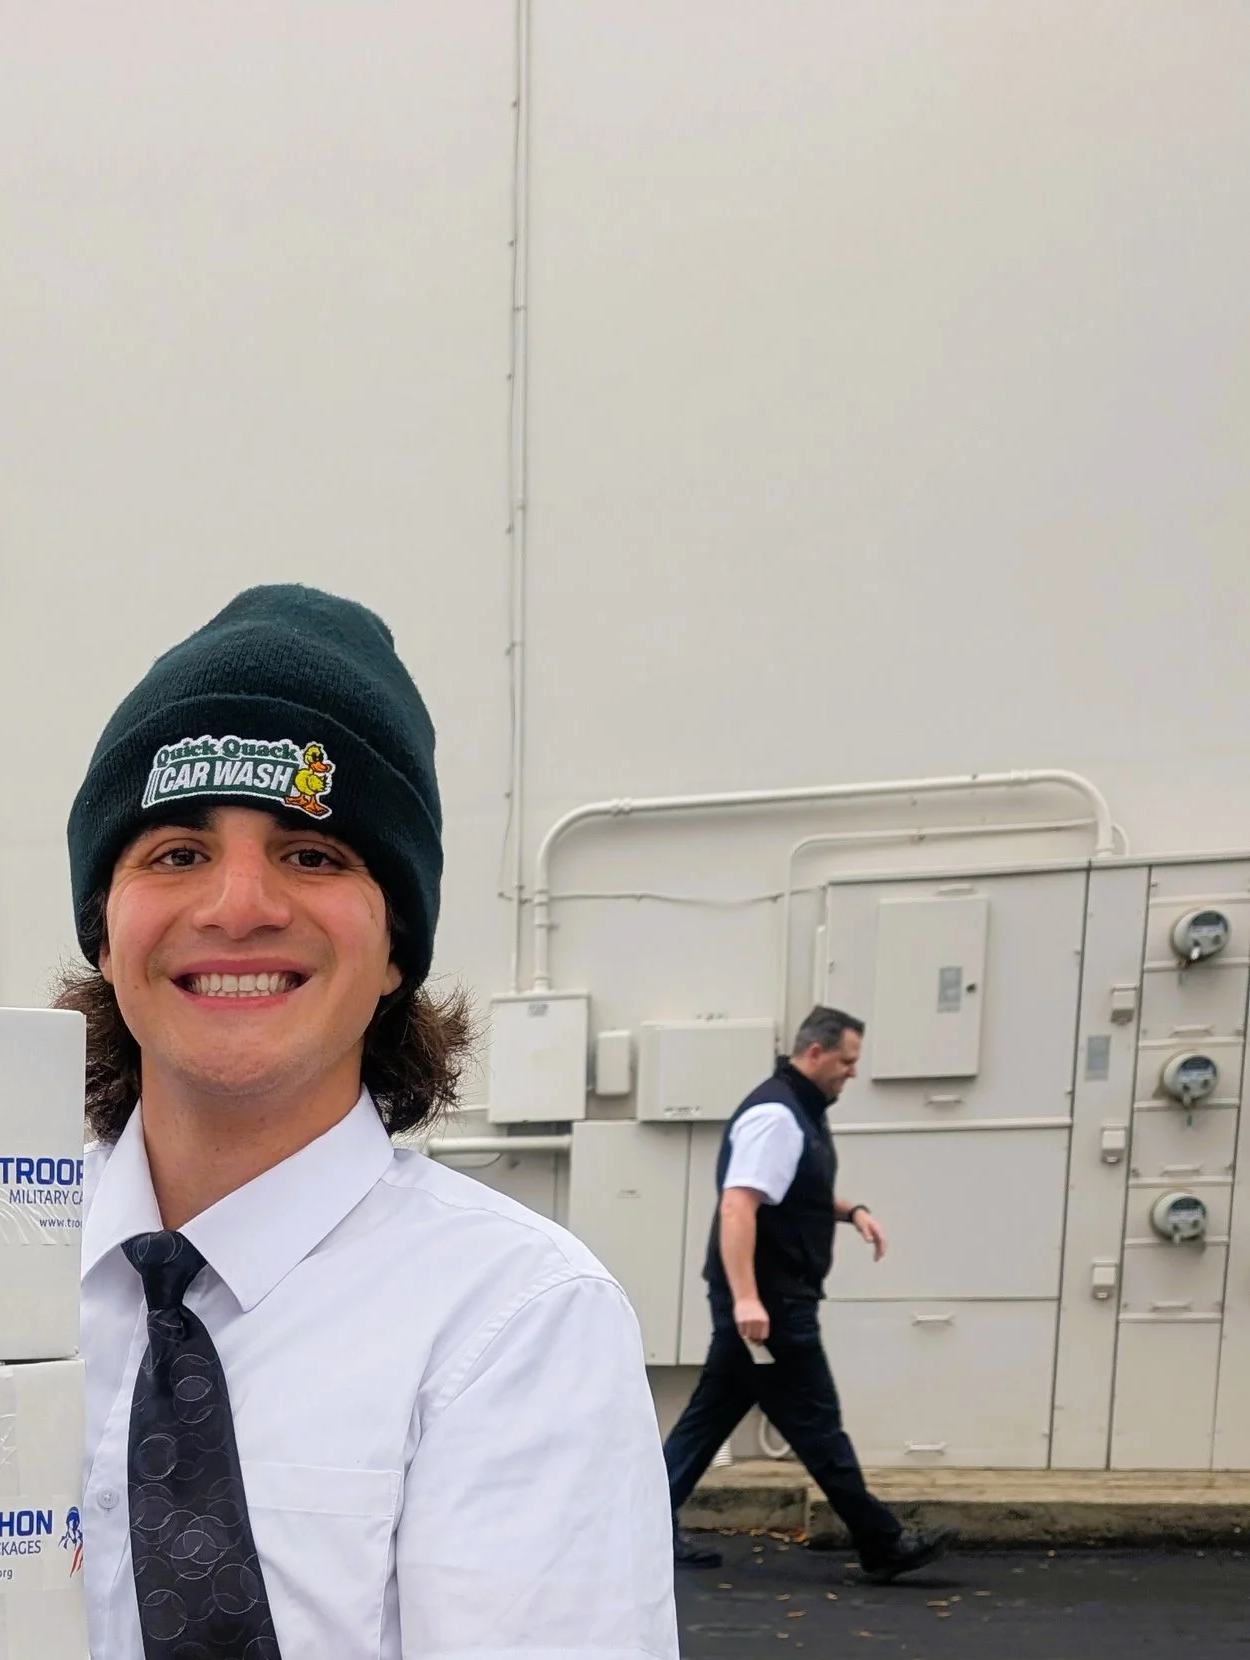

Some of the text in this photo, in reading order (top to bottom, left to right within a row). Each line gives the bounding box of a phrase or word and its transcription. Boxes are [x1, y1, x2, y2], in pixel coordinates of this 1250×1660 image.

[156, 737, 299, 767] Quick Quack
[159, 761, 294, 793] CAR WASH
[9, 1189, 70, 1206] MILITARY
